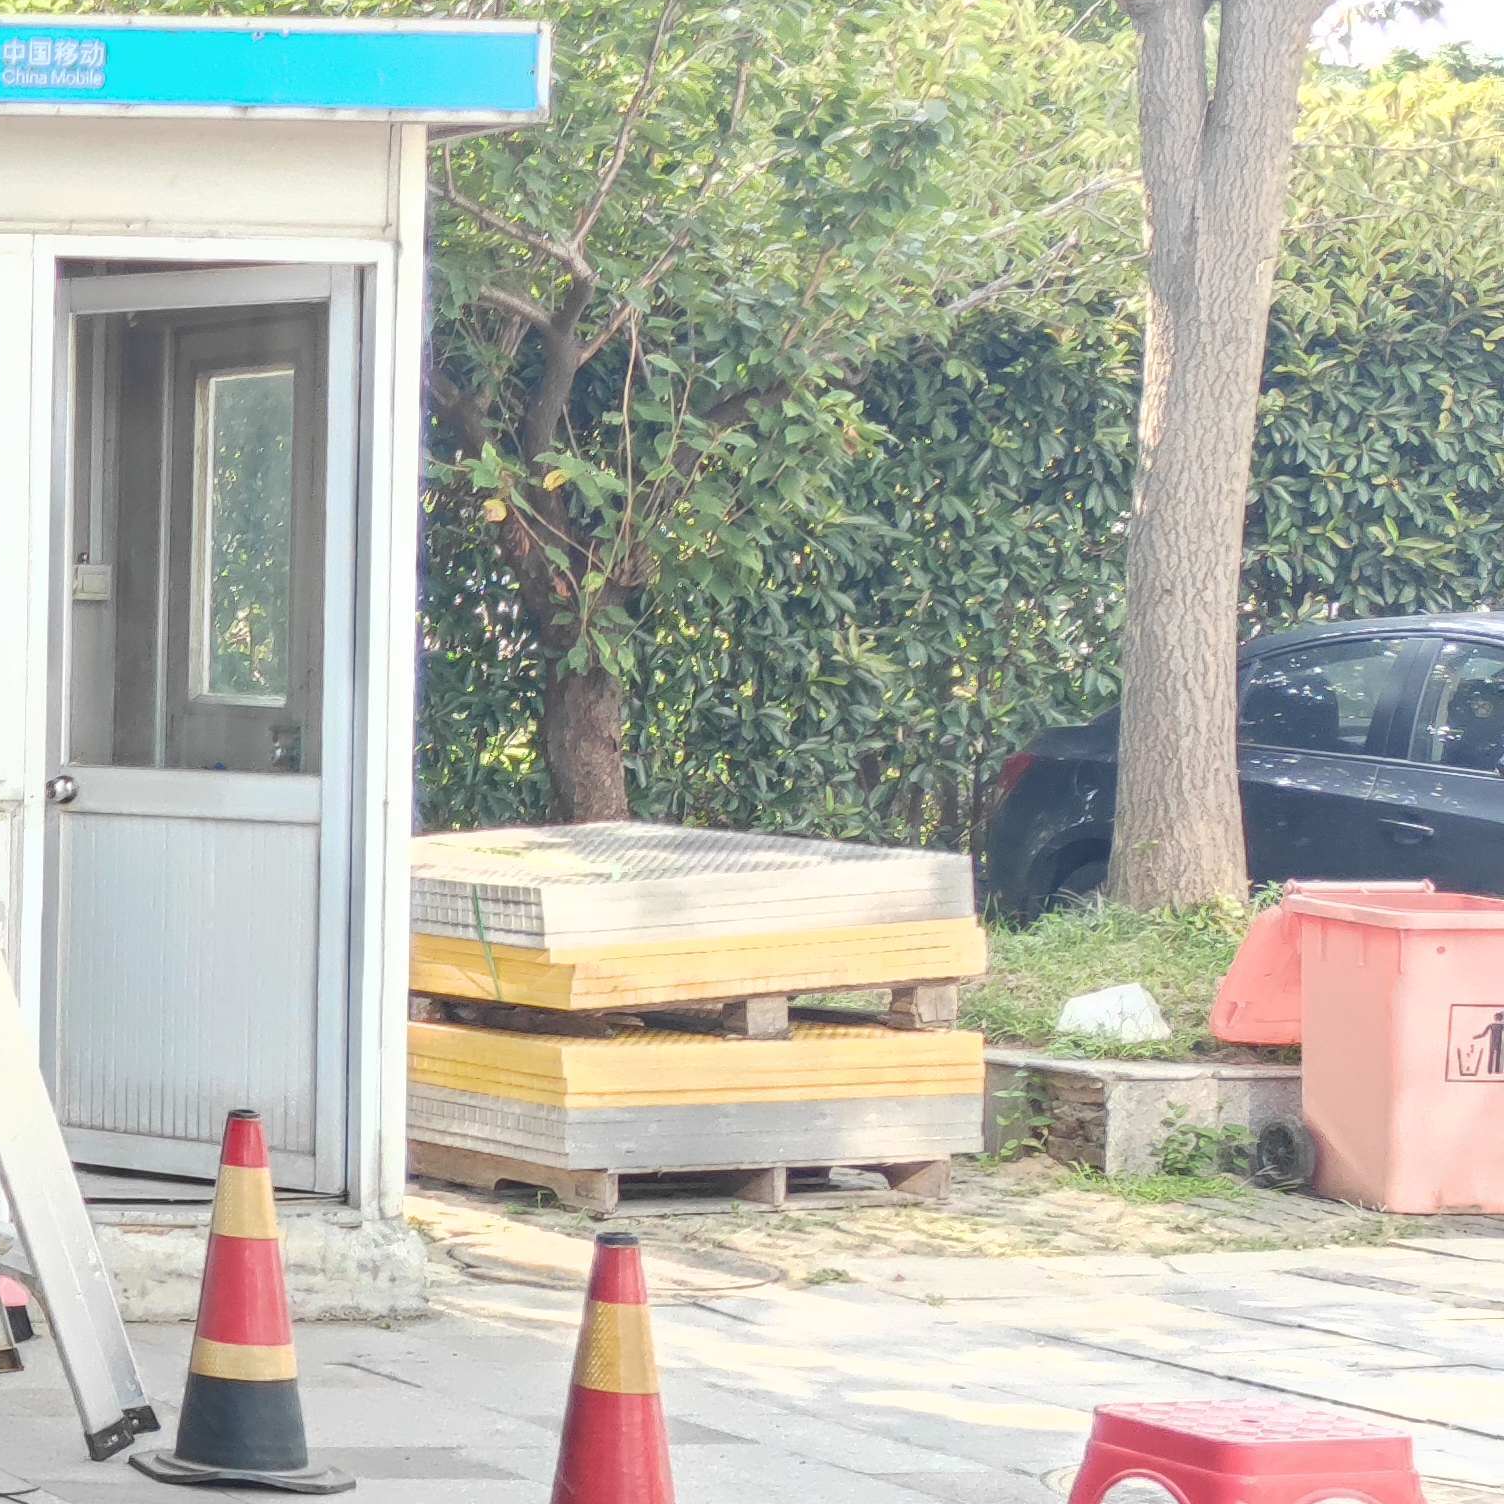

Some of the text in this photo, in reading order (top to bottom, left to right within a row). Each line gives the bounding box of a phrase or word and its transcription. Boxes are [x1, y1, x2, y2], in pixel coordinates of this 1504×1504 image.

[1, 37, 106, 66] 中国移动
[2, 68, 105, 86] China Mobile
